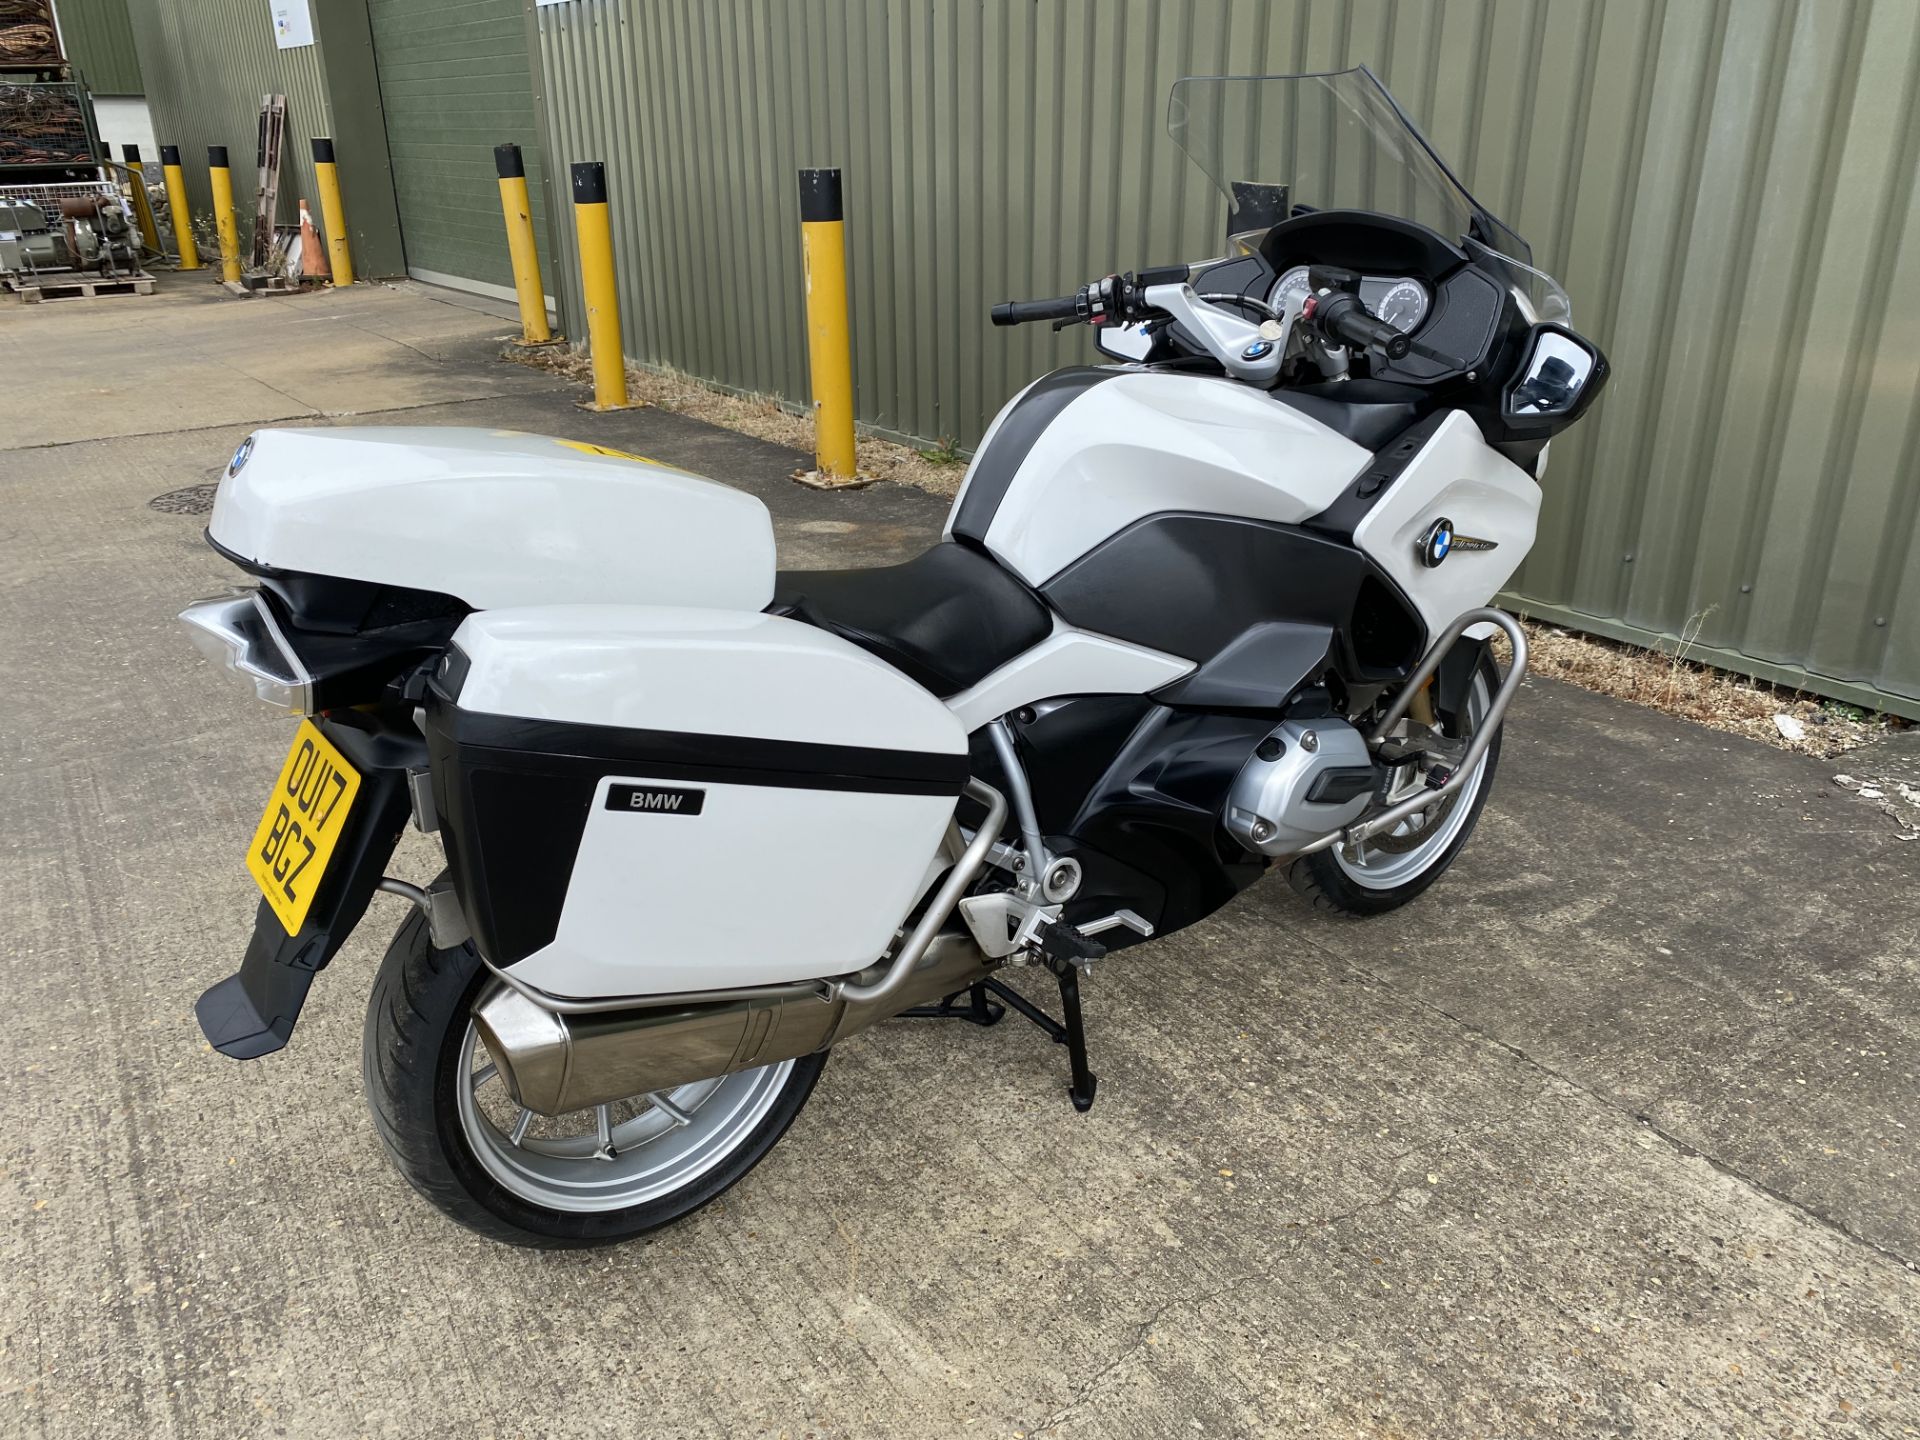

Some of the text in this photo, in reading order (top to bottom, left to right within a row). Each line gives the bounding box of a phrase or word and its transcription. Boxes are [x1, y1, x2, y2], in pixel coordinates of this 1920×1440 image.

[287, 738, 348, 832] OU17
[629, 791, 684, 811] BMW
[260, 802, 317, 905] BGZ
